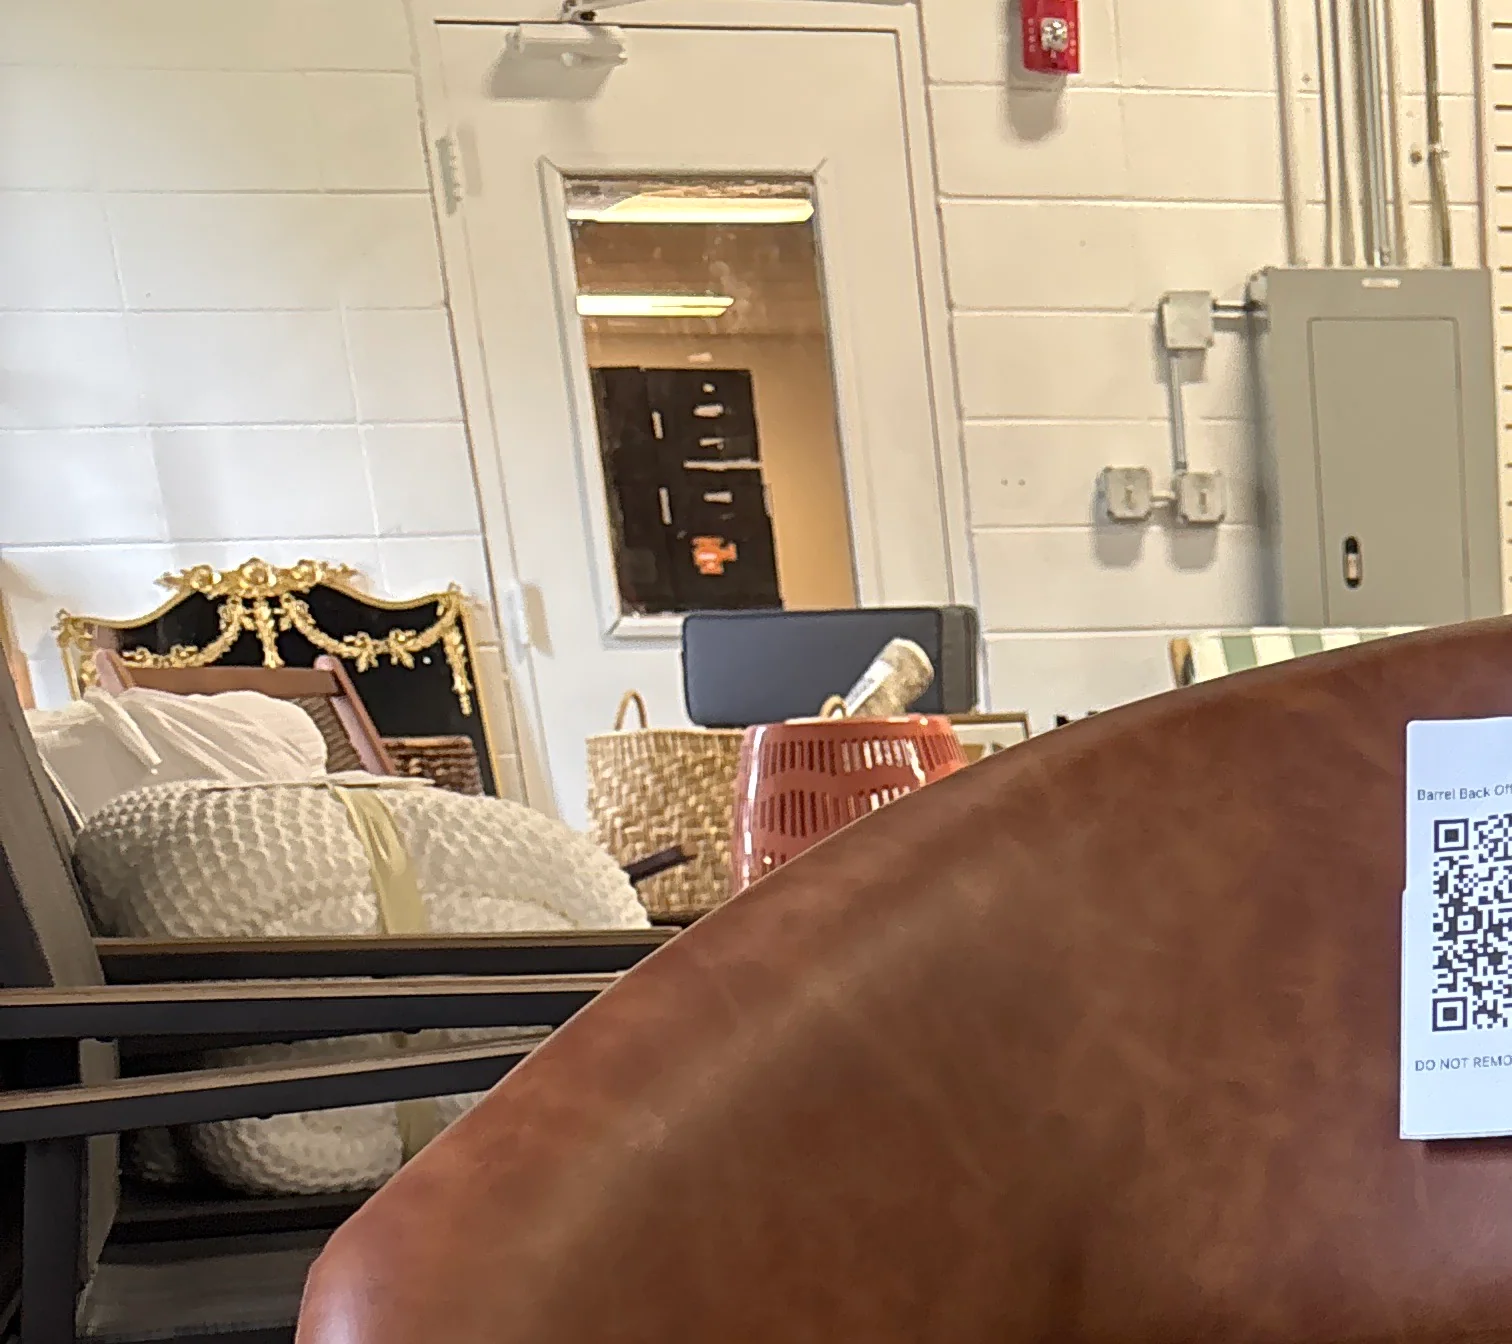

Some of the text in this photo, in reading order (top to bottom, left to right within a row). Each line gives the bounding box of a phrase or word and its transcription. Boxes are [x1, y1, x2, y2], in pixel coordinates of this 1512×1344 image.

[1416, 788, 1456, 801] Barrel
[1459, 786, 1491, 799] Back
[1414, 1058, 1436, 1072] DO
[1439, 1057, 1469, 1071] NOT
